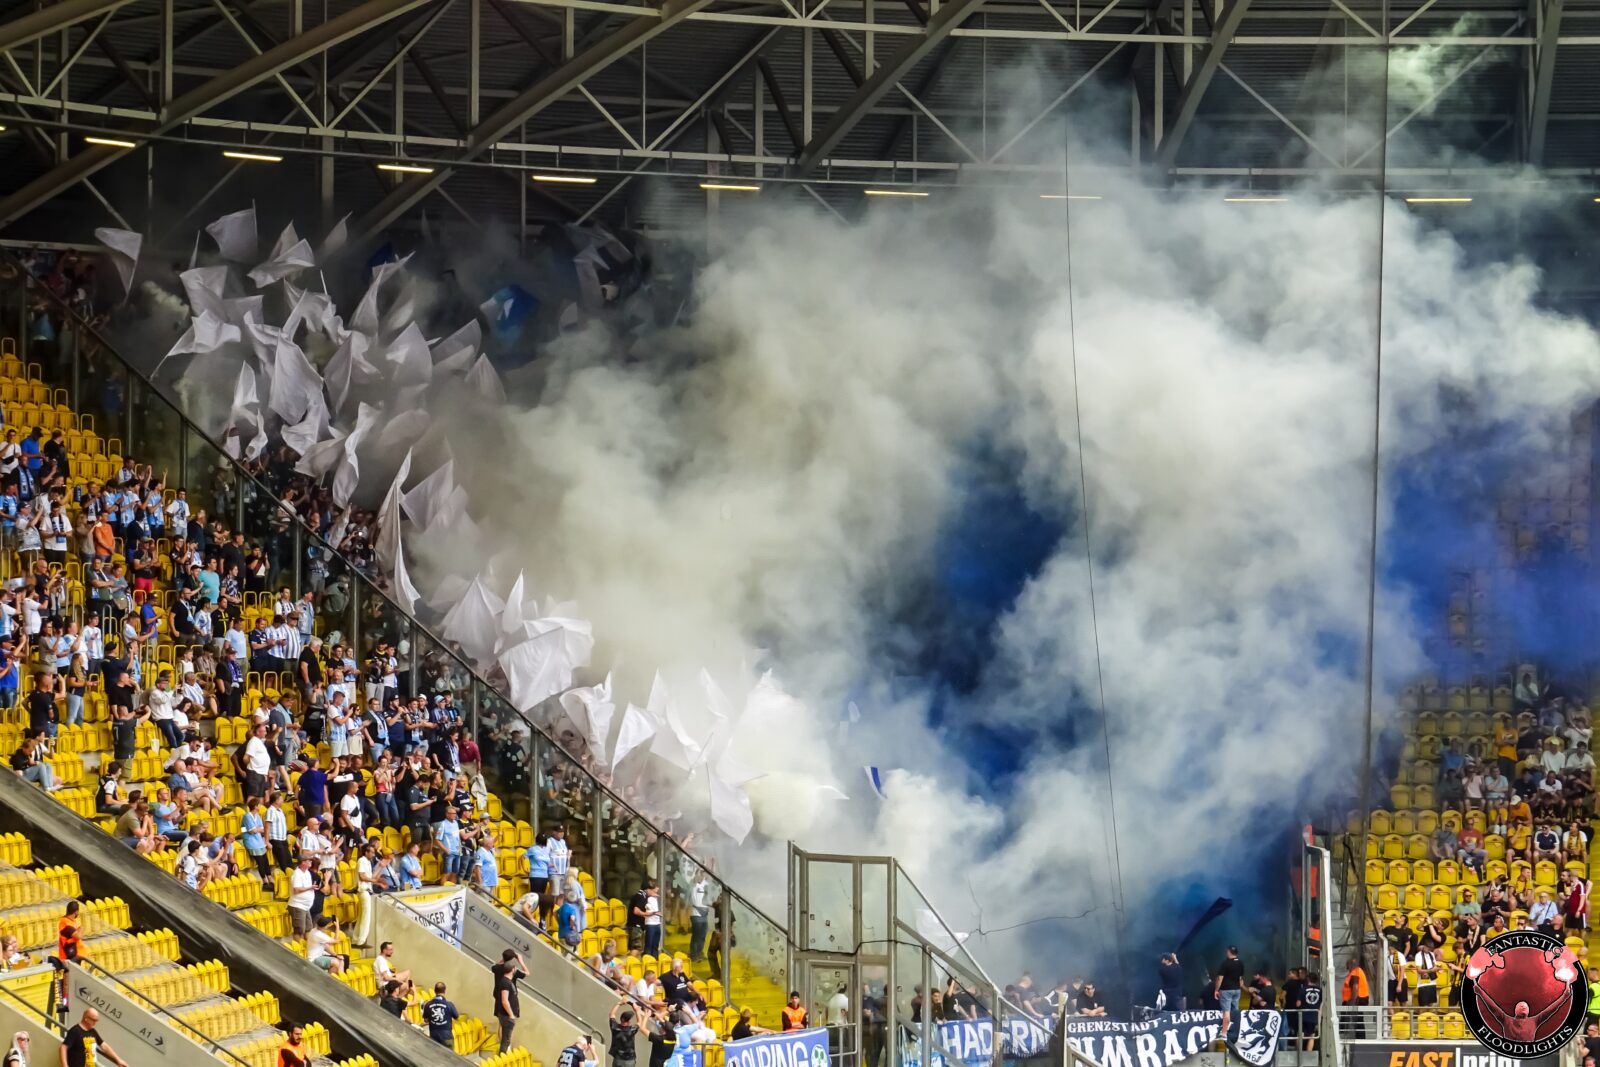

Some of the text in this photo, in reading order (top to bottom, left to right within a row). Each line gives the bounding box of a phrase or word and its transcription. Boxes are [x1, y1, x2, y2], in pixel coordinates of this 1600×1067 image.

[93, 997, 122, 1019] A2 A3
[139, 1027, 152, 1039] A1
[1462, 1051, 1521, 1067] rin
